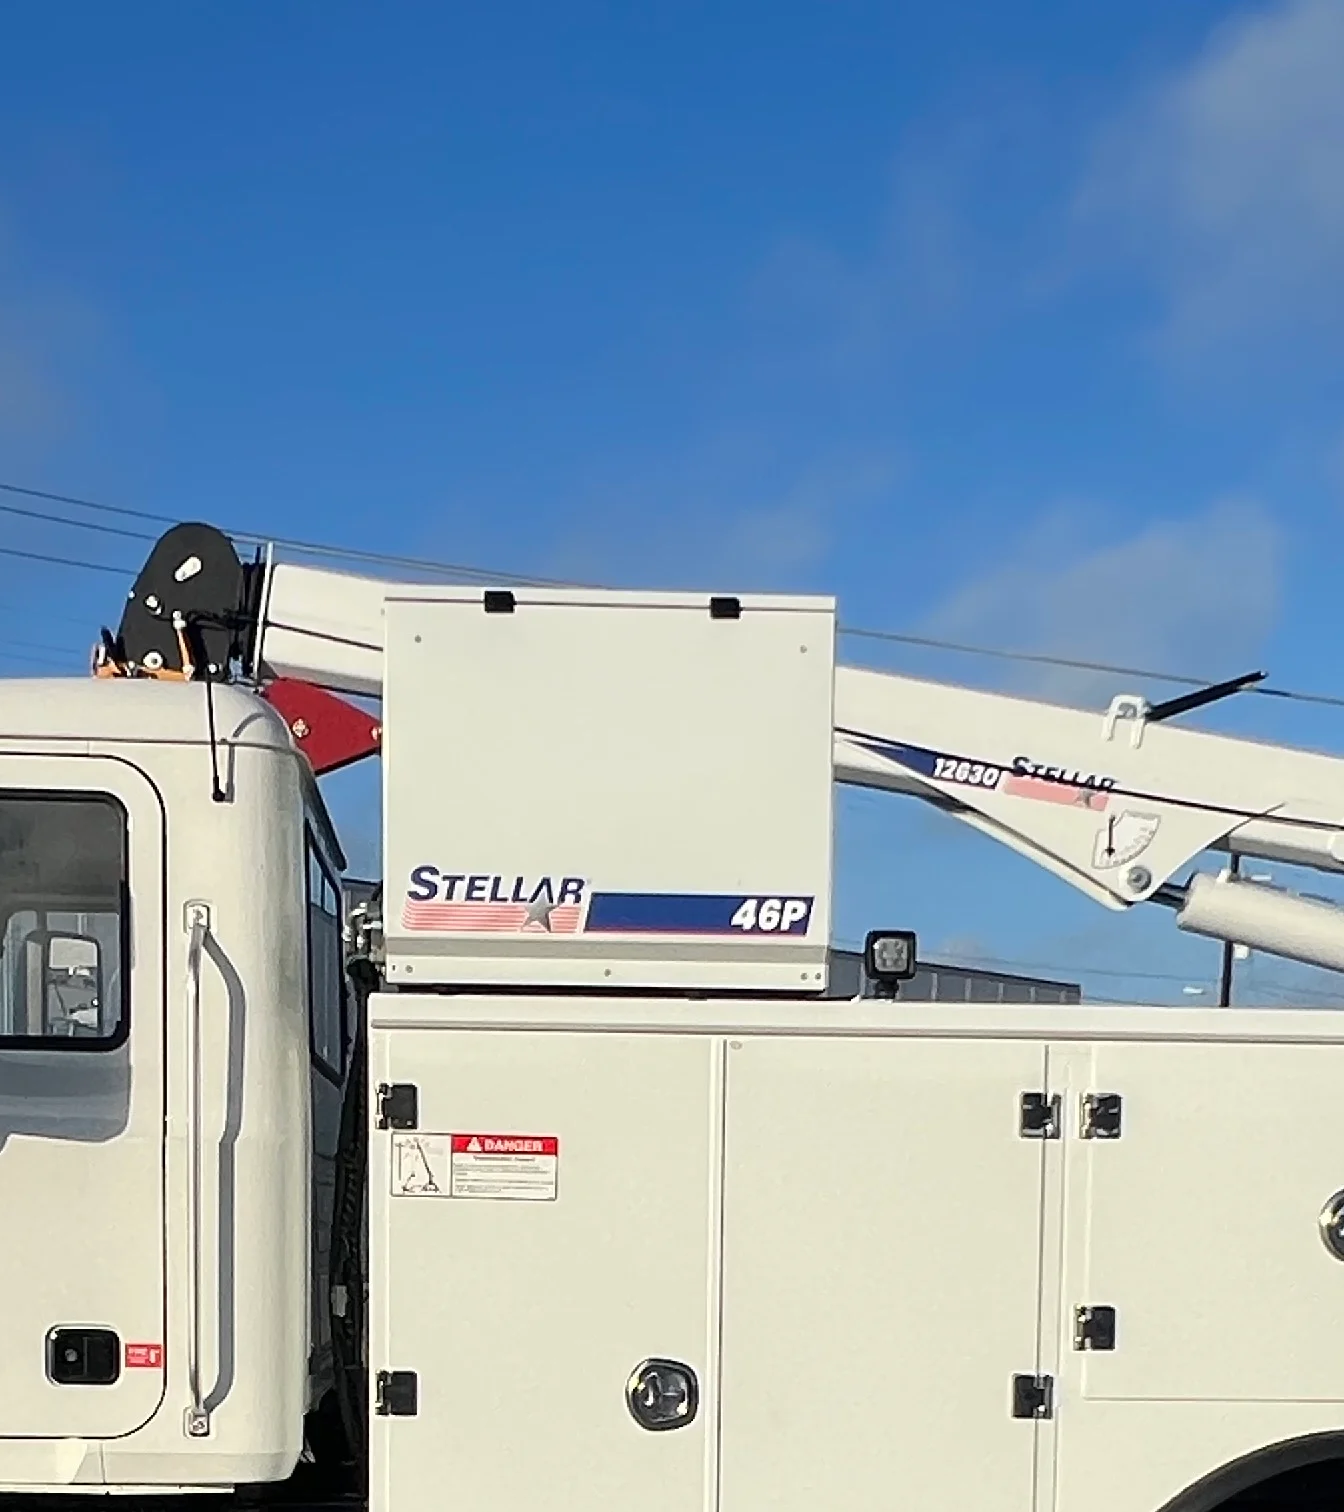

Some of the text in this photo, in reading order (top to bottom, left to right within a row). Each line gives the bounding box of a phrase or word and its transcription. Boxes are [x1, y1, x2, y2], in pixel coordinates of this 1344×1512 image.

[407, 864, 808, 931] STELLAR 46P
[484, 1138, 544, 1152] DANGER
